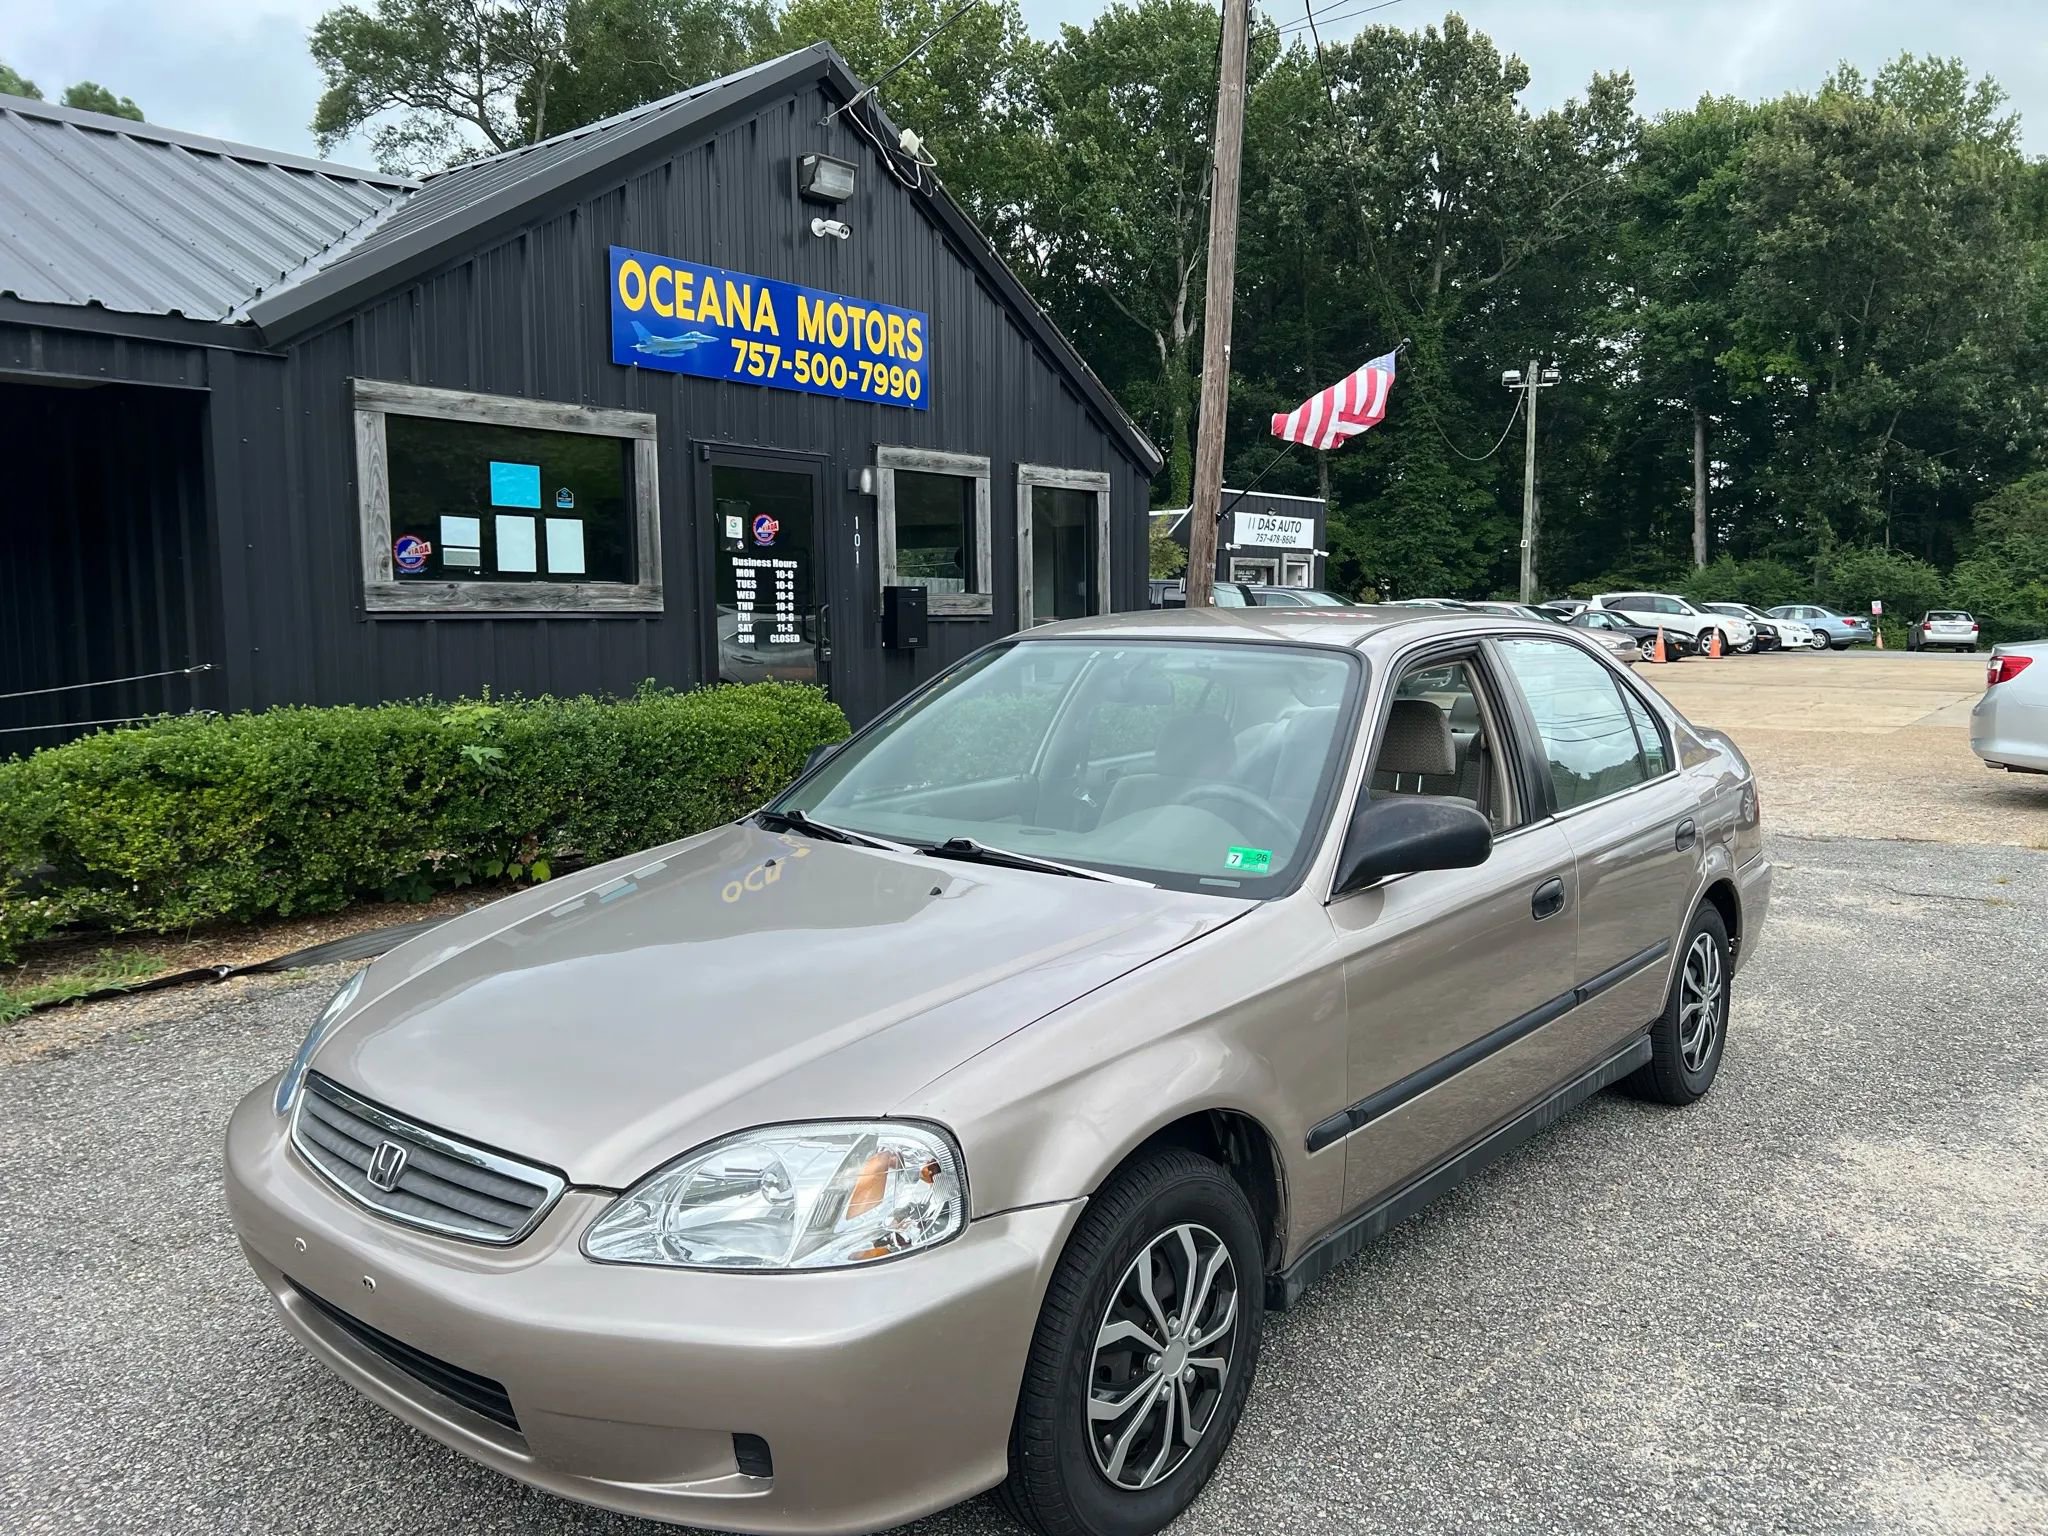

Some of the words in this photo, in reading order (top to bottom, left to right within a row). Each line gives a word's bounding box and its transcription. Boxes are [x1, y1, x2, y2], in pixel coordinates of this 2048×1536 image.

[618, 259, 779, 337] OCEANA
[797, 295, 924, 363] MOTORS
[730, 338, 921, 401] 757-500-7990
[1258, 518, 1277, 531] DAS
[1277, 520, 1302, 533] AUTO
[732, 557, 771, 567] Business
[772, 559, 797, 568] Hours
[736, 568, 756, 578] MON
[775, 569, 794, 579] 10-6
[736, 579, 757, 589] TUES
[775, 580, 794, 590] 10-6
[736, 590, 756, 600] WED
[775, 591, 795, 601] 10-6
[737, 601, 754, 611] THU
[775, 602, 795, 611] 10-6
[737, 612, 751, 622] FRI
[775, 612, 795, 622] 10-6
[738, 623, 754, 633] SAT
[776, 623, 794, 633] 11-5
[738, 634, 756, 644] SUN
[770, 633, 801, 644] CLOSED
[1231, 854, 1239, 864] 7
